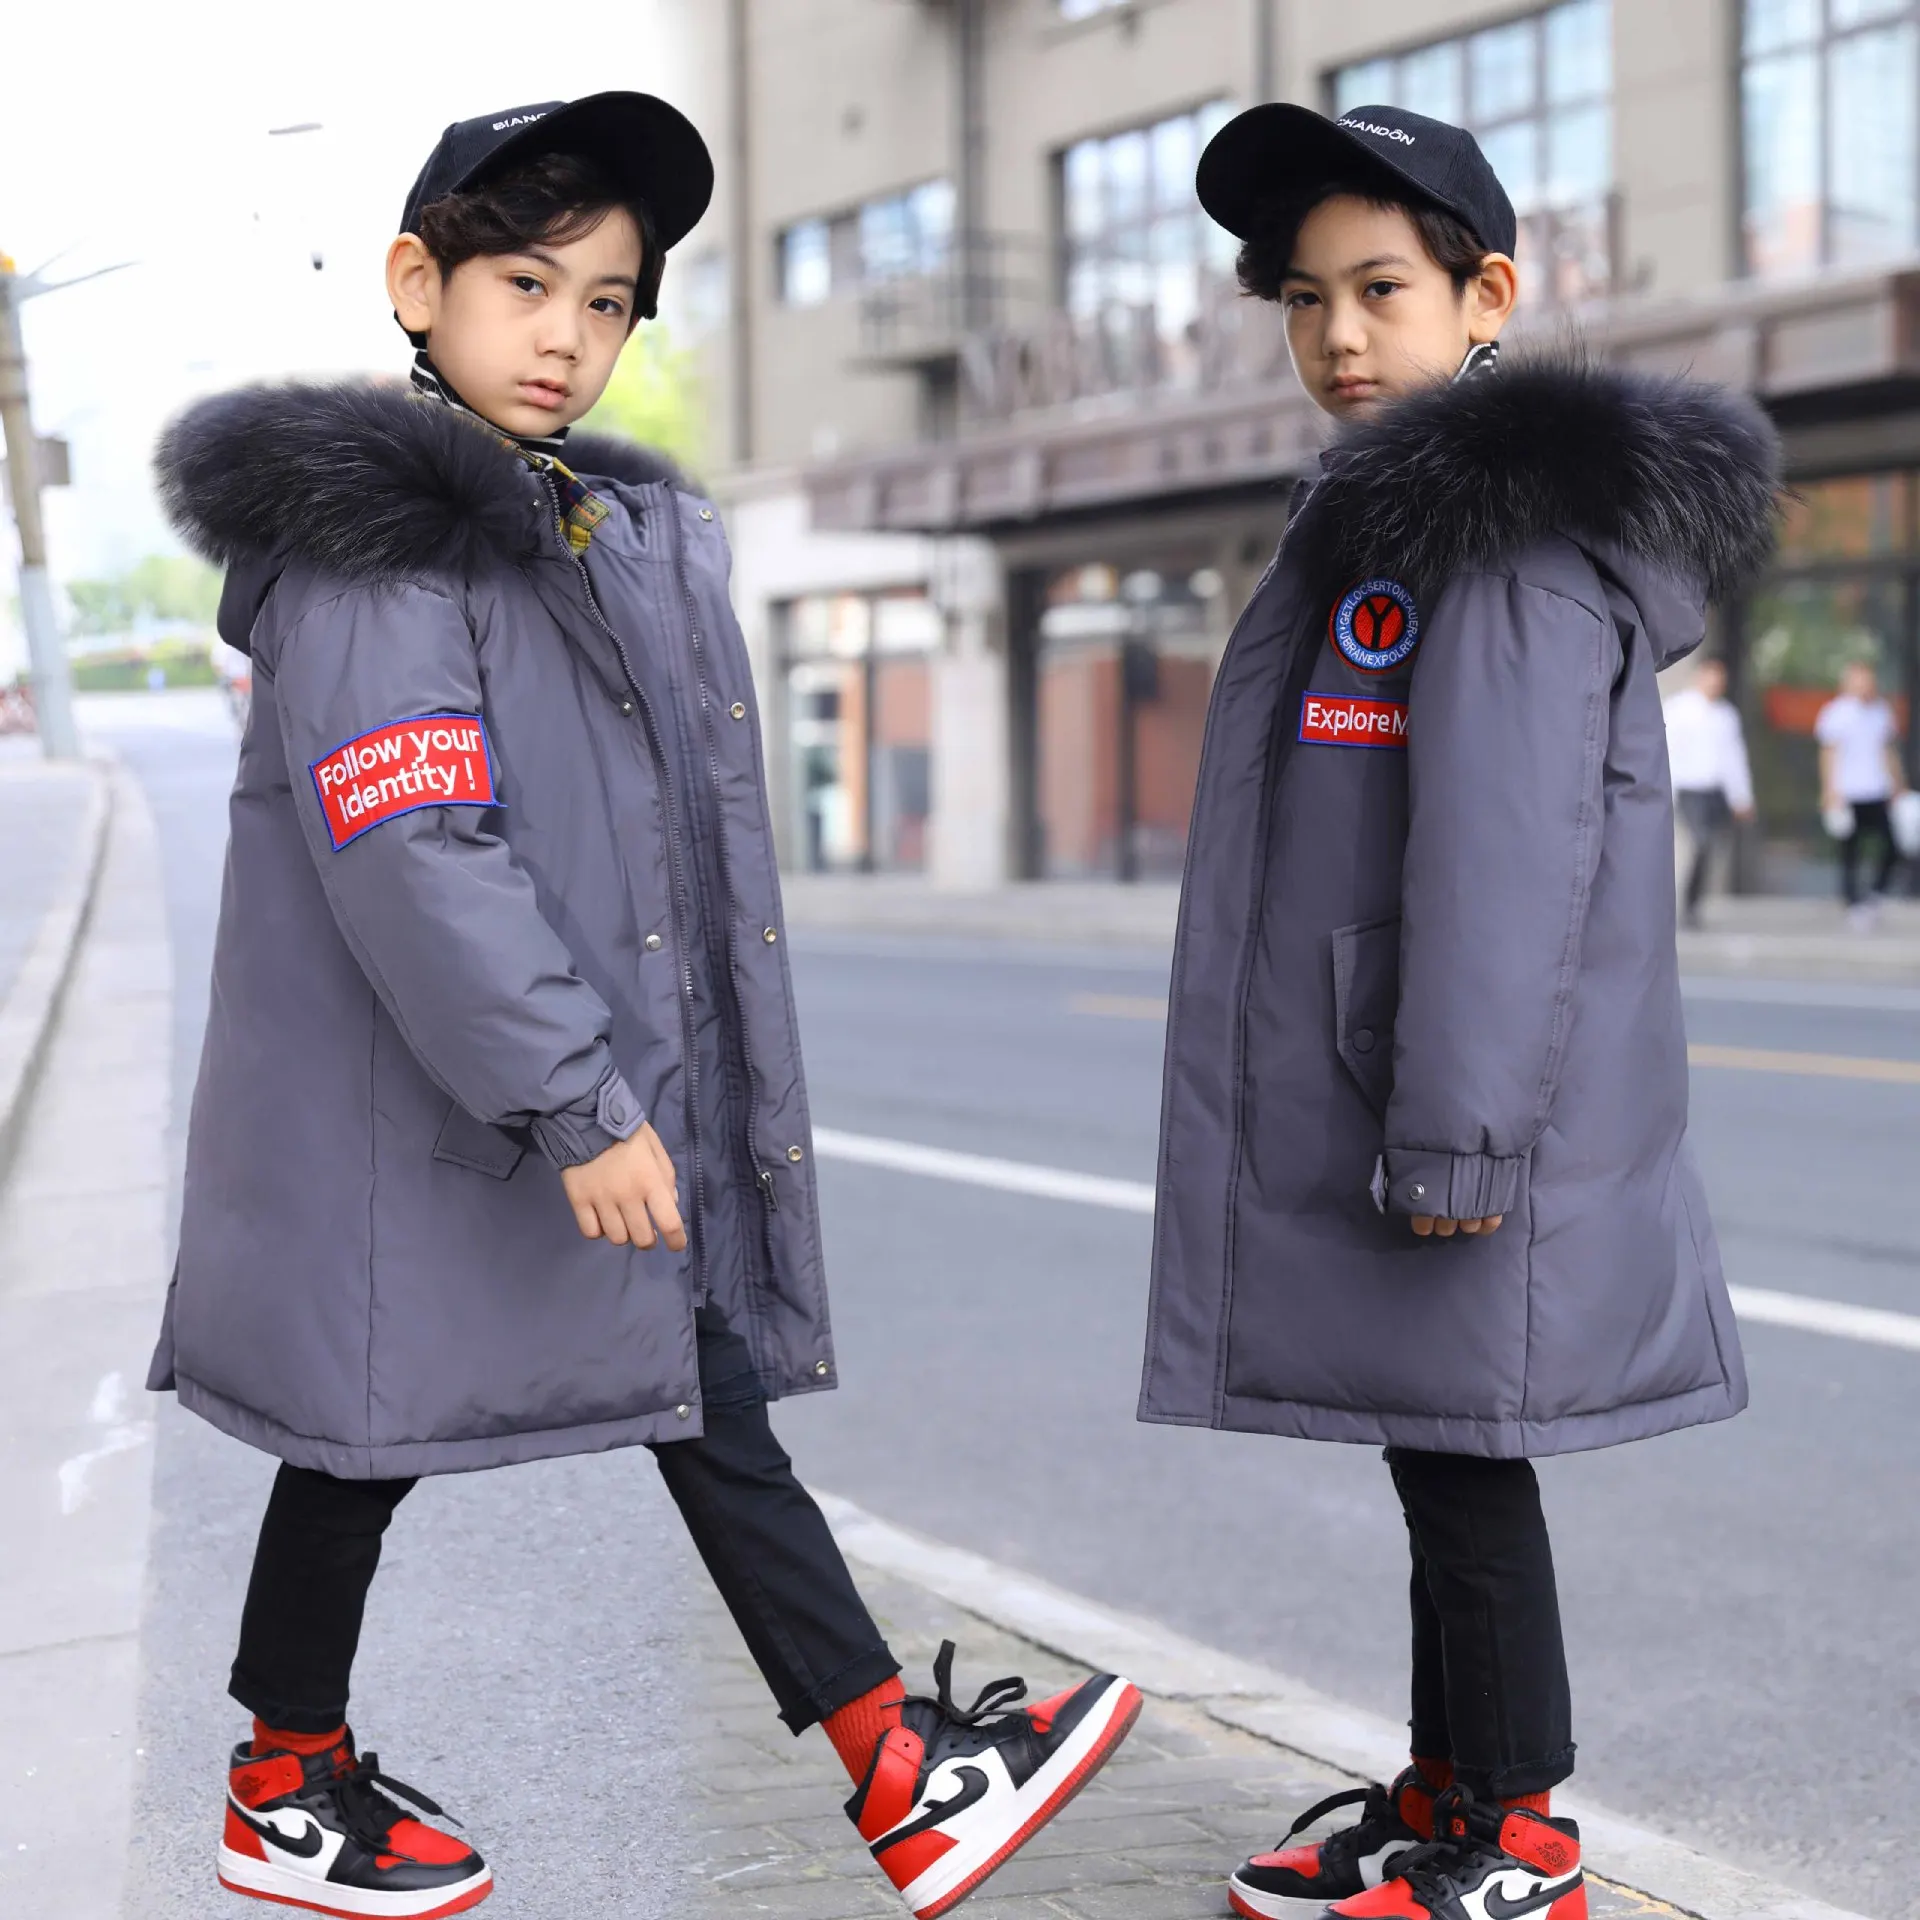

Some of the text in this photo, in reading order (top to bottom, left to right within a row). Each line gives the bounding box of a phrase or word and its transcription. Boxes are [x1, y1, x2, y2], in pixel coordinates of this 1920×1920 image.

[319, 728, 480, 796] Follow your
[337, 762, 457, 824] Identity
